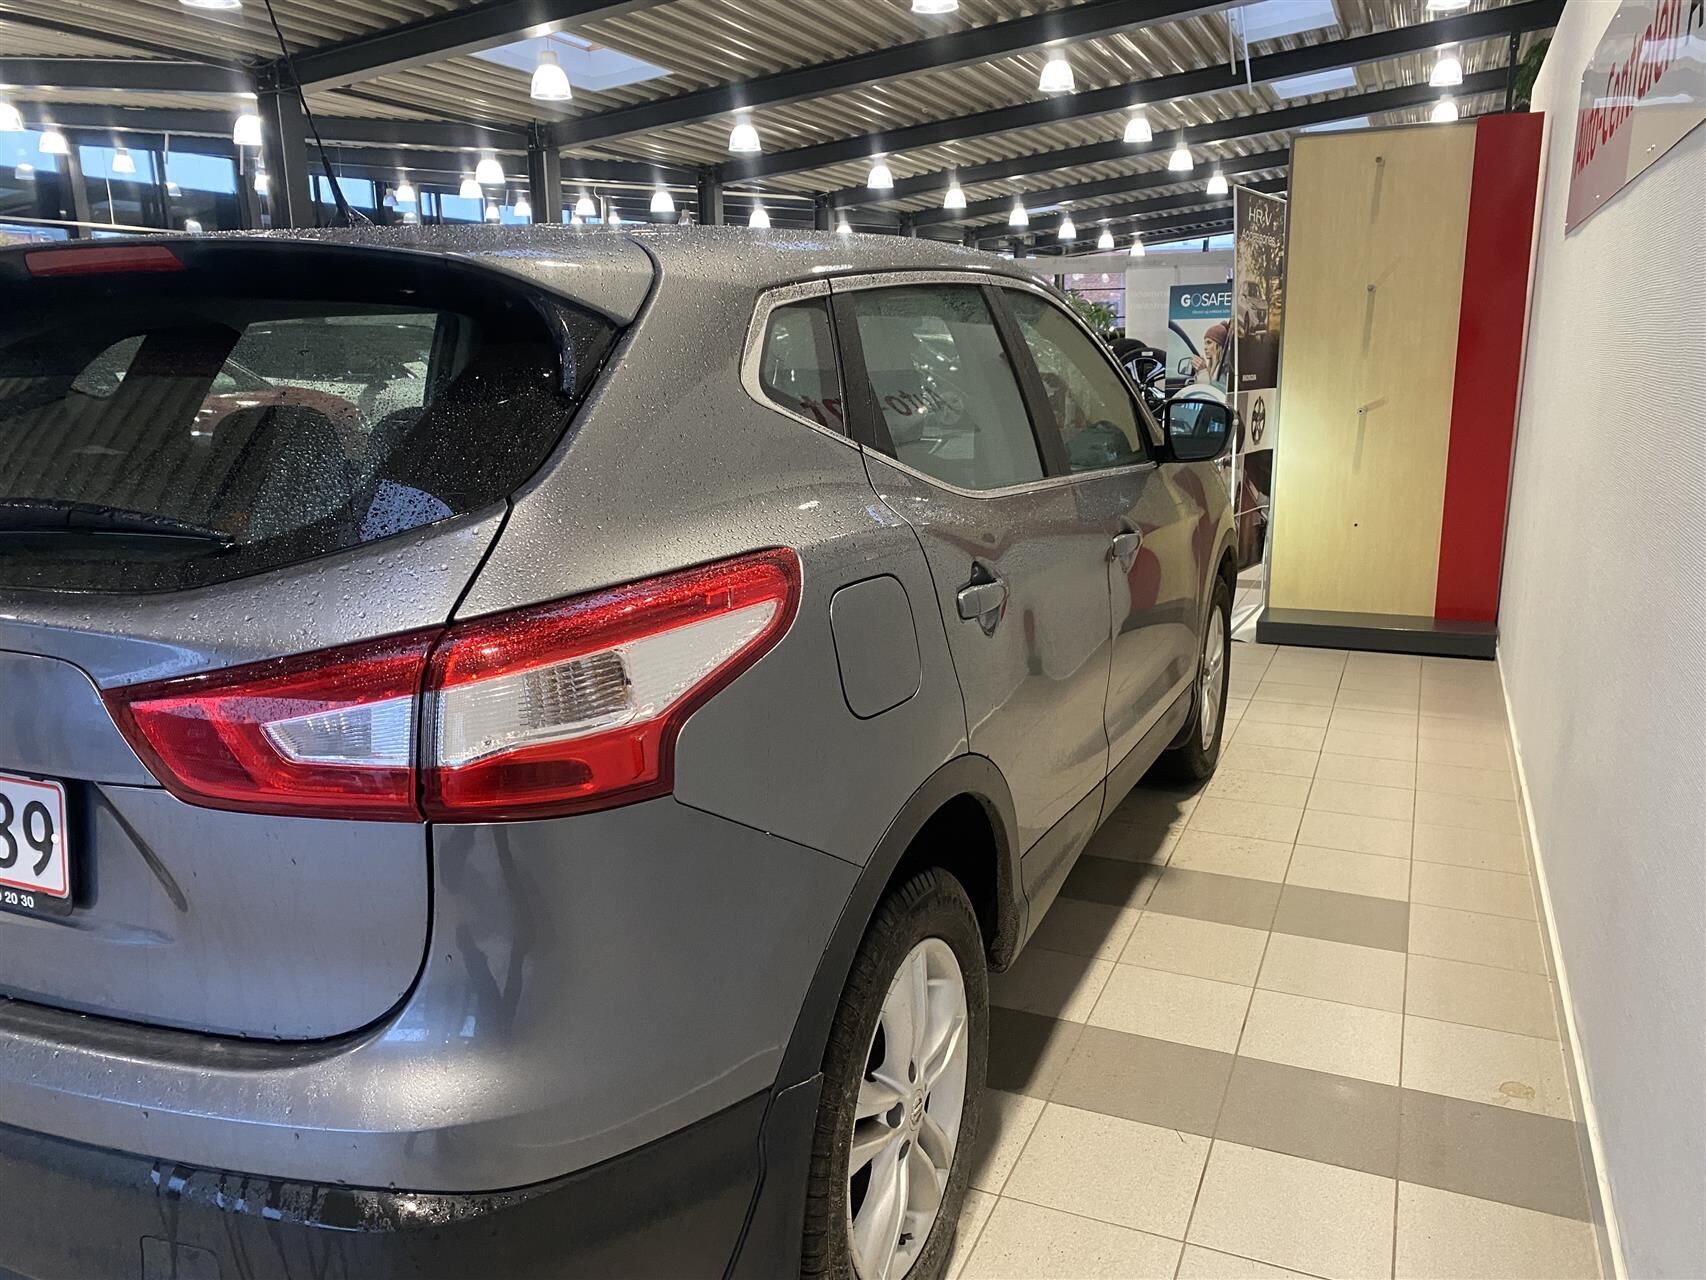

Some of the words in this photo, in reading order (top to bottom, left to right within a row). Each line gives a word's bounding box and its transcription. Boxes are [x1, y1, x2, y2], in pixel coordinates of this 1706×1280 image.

[1181, 292, 1232, 308] GOSAFE
[4, 891, 18, 905] 20
[20, 895, 35, 908] 30
